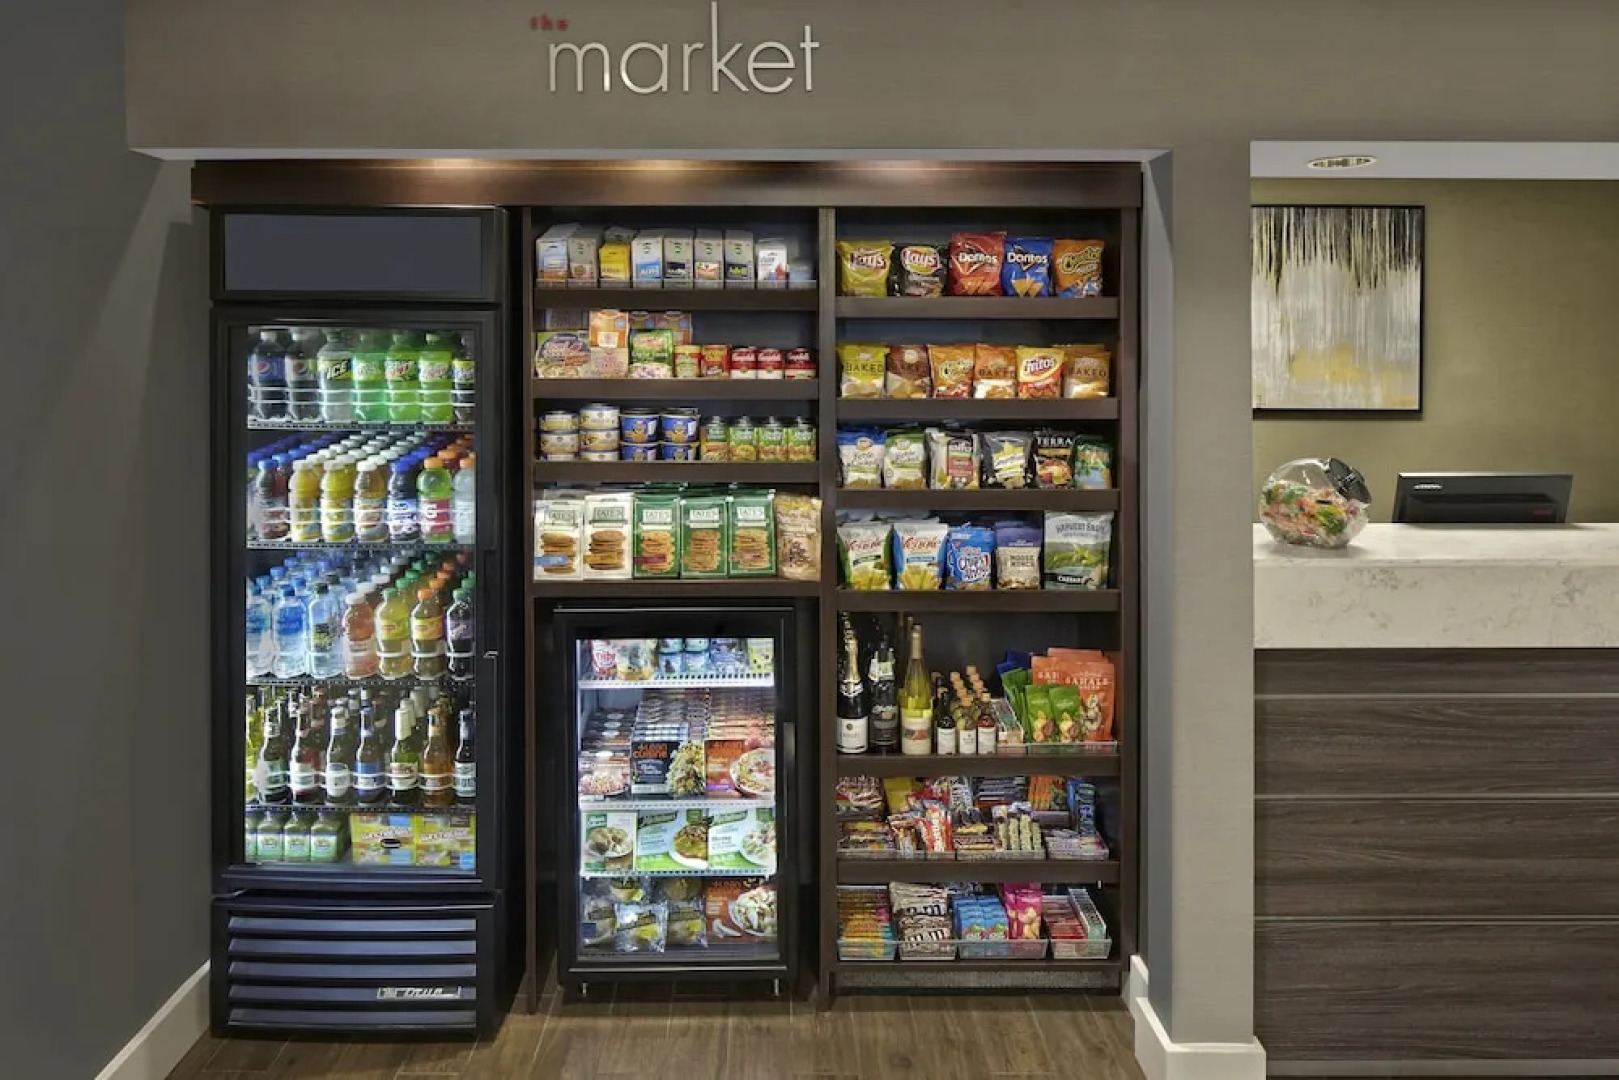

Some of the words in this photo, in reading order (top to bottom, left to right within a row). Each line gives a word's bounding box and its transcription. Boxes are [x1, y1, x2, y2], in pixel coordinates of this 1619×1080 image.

[530, 14, 570, 32] the
[549, 2, 821, 94] market
[958, 252, 998, 263] Doritos
[1006, 252, 1049, 264] Doritos
[1036, 436, 1073, 446] TERRA
